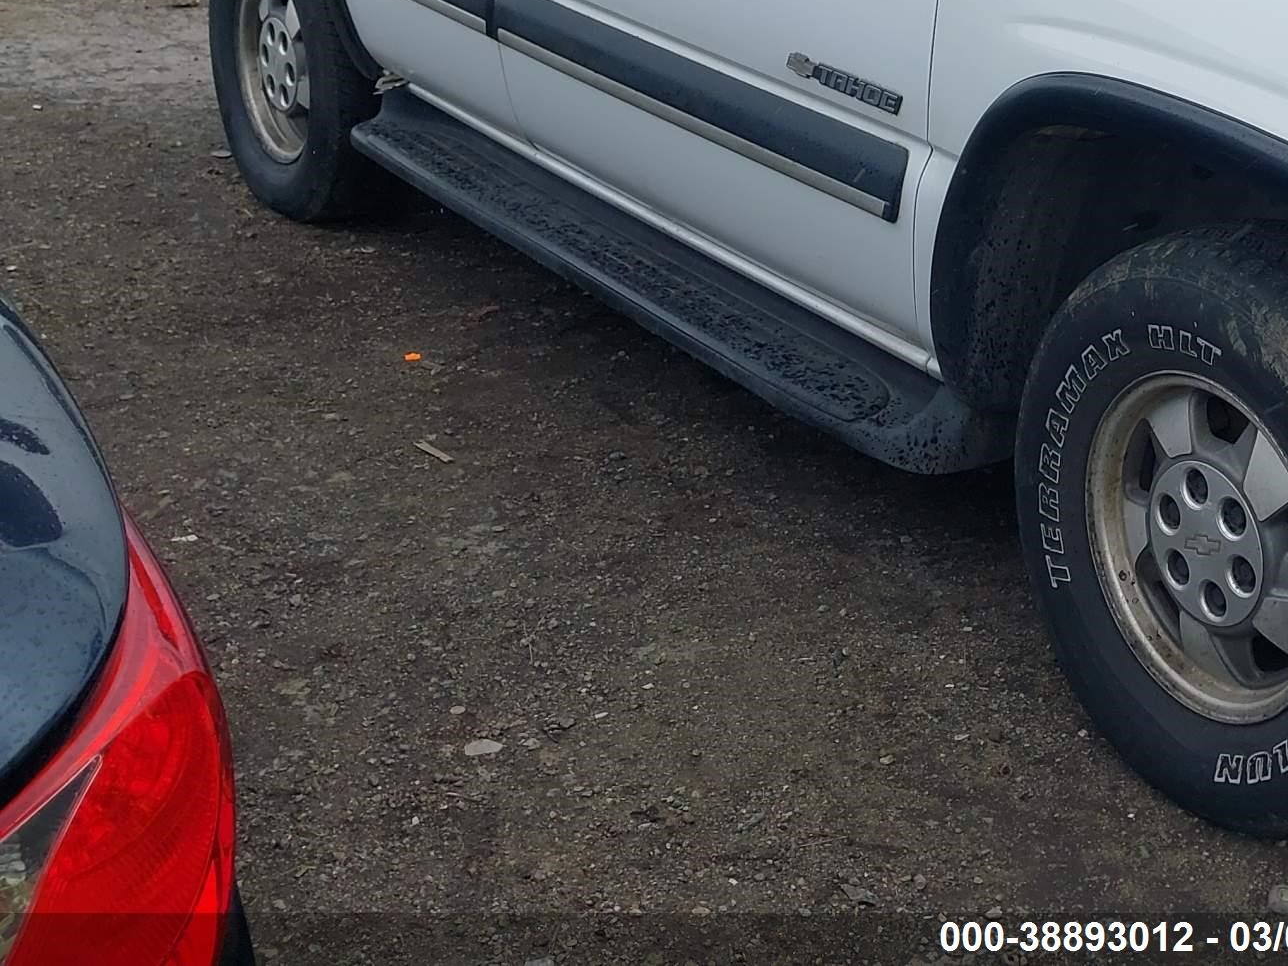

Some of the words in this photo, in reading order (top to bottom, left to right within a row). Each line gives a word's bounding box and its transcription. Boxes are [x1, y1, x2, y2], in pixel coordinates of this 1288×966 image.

[817, 64, 900, 113] TAHOE
[1039, 329, 1130, 588] TERRAMAX
[1148, 324, 1222, 366] HLT
